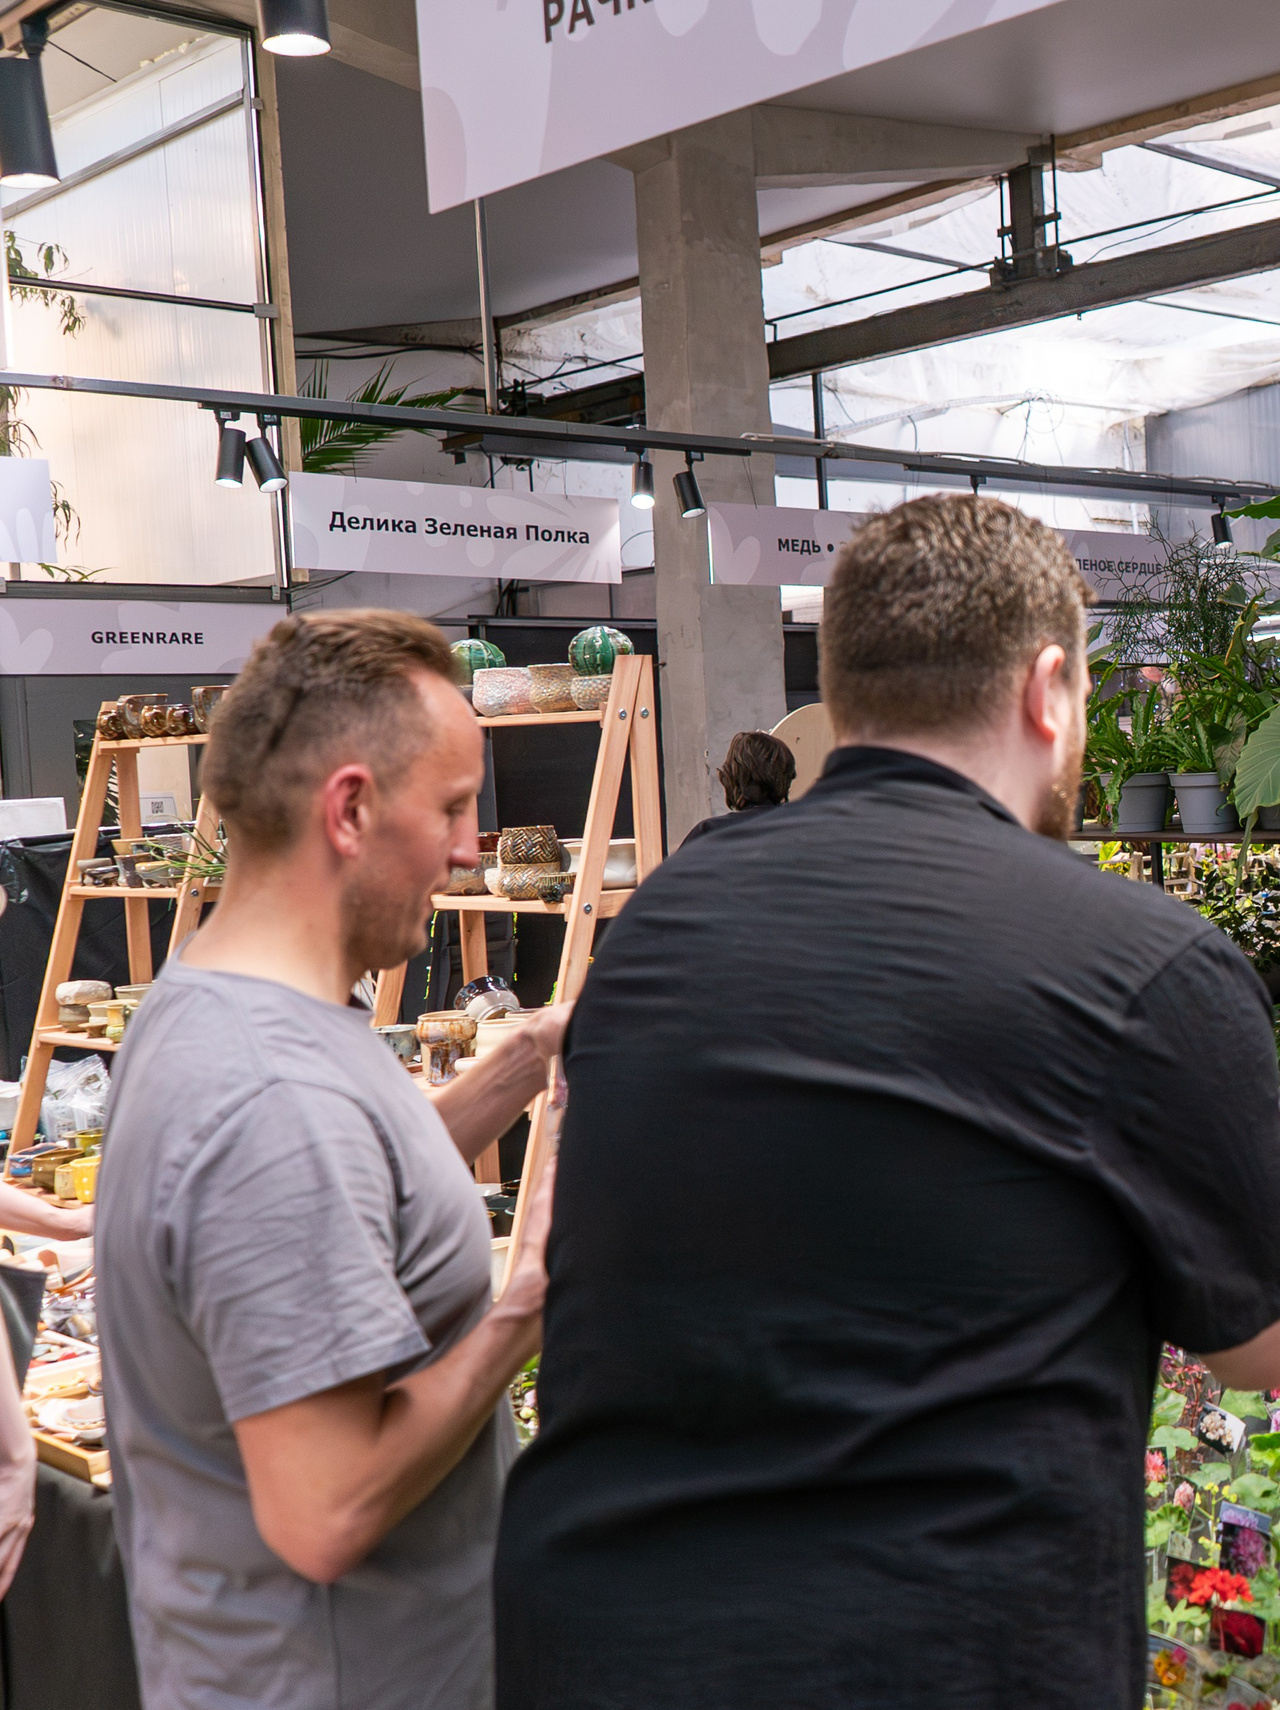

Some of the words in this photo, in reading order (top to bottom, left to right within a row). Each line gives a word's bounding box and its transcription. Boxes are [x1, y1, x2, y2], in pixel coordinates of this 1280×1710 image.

[329, 511, 417, 533] Делика
[424, 517, 518, 540] Зеленая
[525, 524, 591, 544] Полка
[778, 538, 821, 556] МЕДЬ
[1117, 560, 1163, 577] СЕРДЦЕ
[91, 631, 204, 645] GREENRARE
